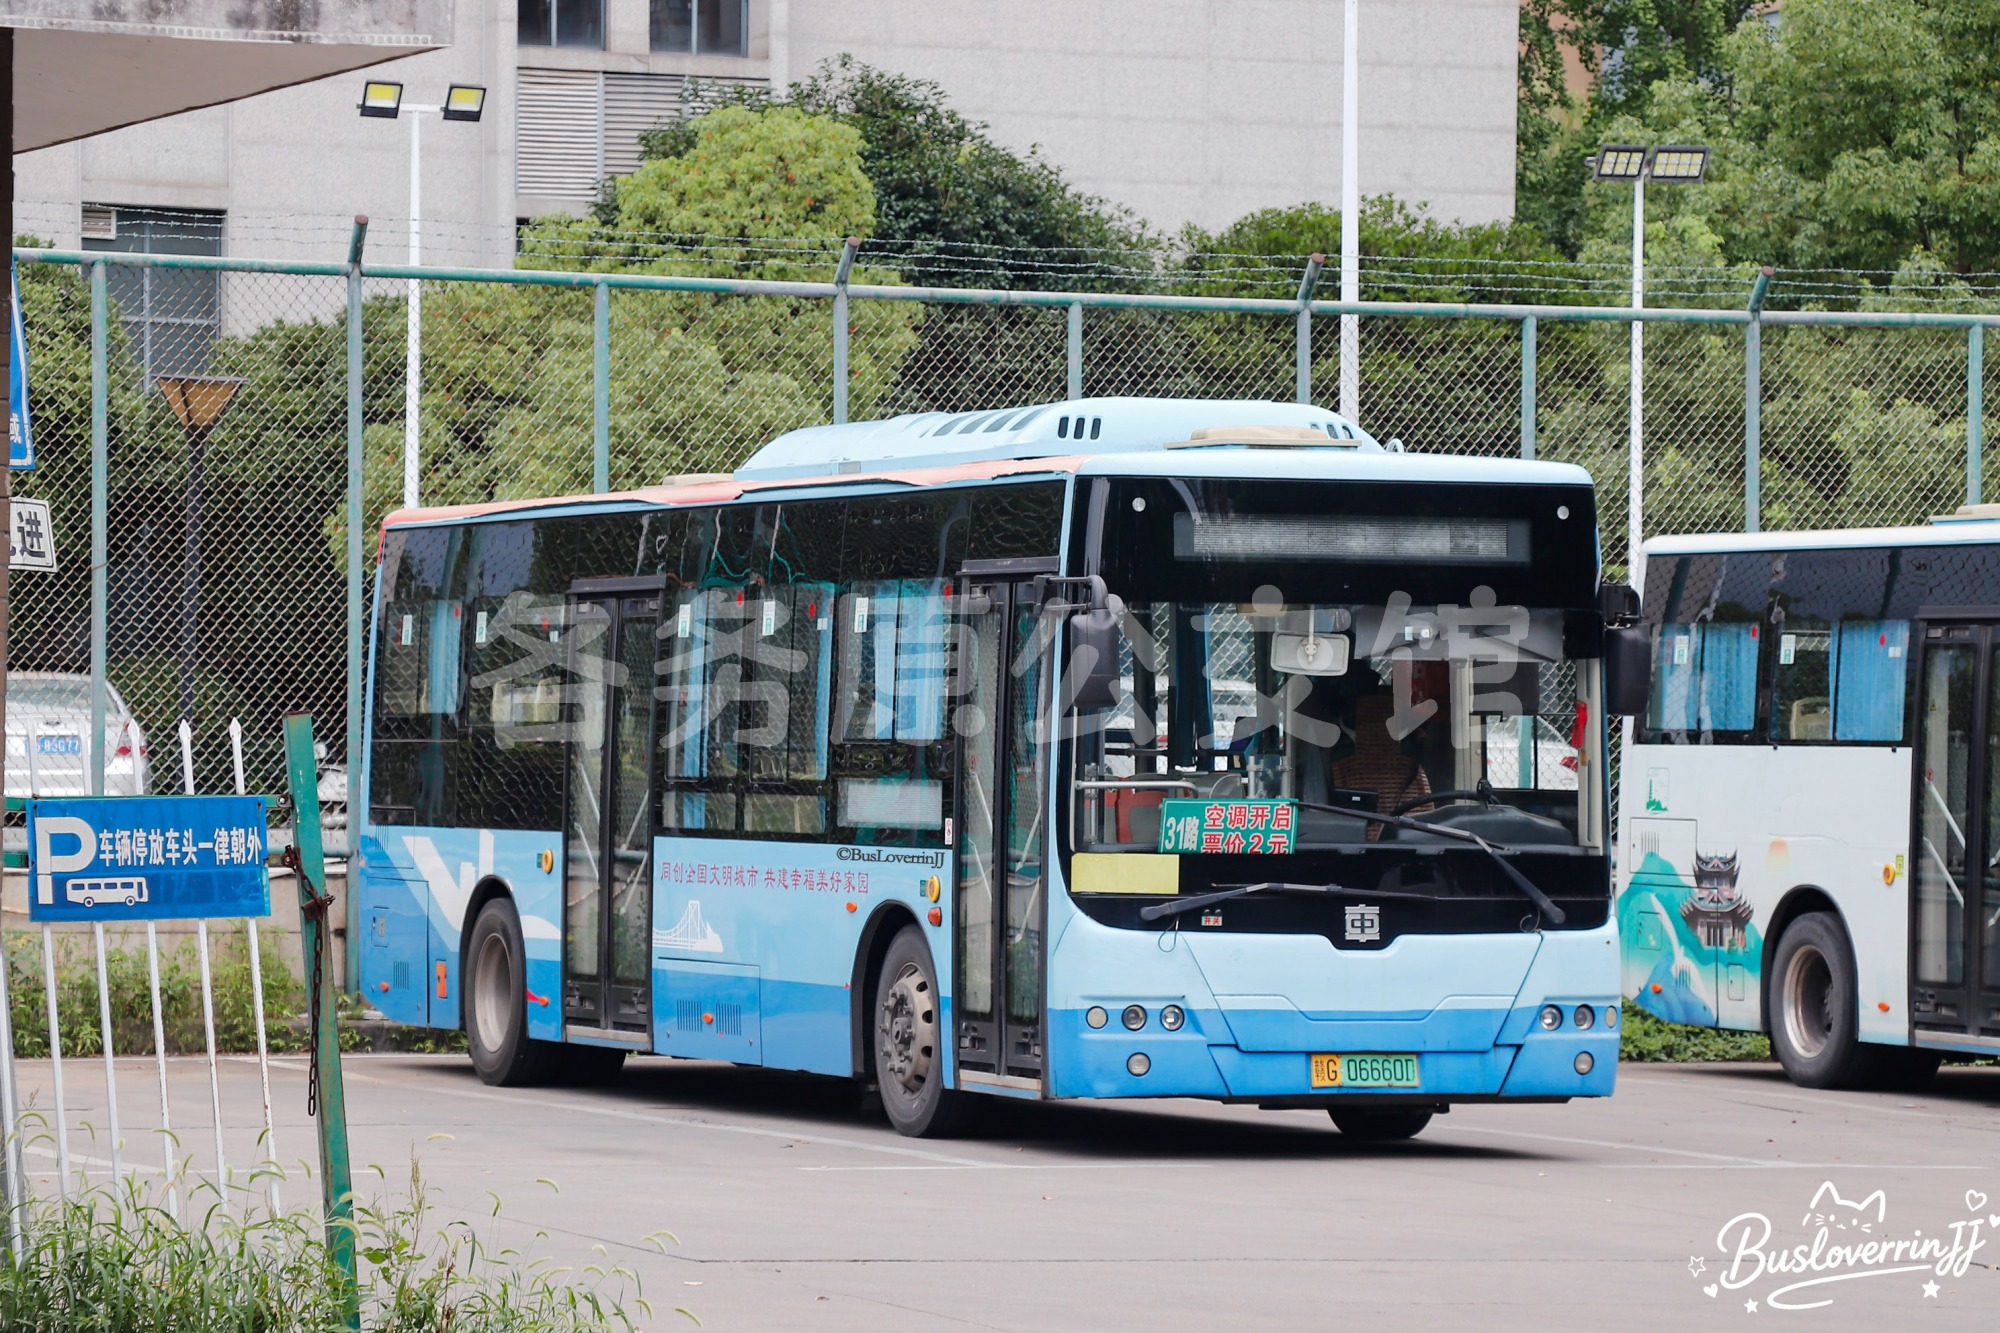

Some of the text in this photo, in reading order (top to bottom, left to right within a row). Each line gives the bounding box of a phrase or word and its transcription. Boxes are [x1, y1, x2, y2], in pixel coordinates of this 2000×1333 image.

[10, 511, 45, 558] 进
[1165, 816, 1199, 850] 31路
[1204, 804, 1292, 830] 空调开启
[35, 817, 97, 904] P
[99, 826, 263, 868] 车辆停放车头一律朝外
[661, 861, 869, 894] 同创全国文明城市 共建幸福美好家园
[1204, 916, 1220, 925] 开关
